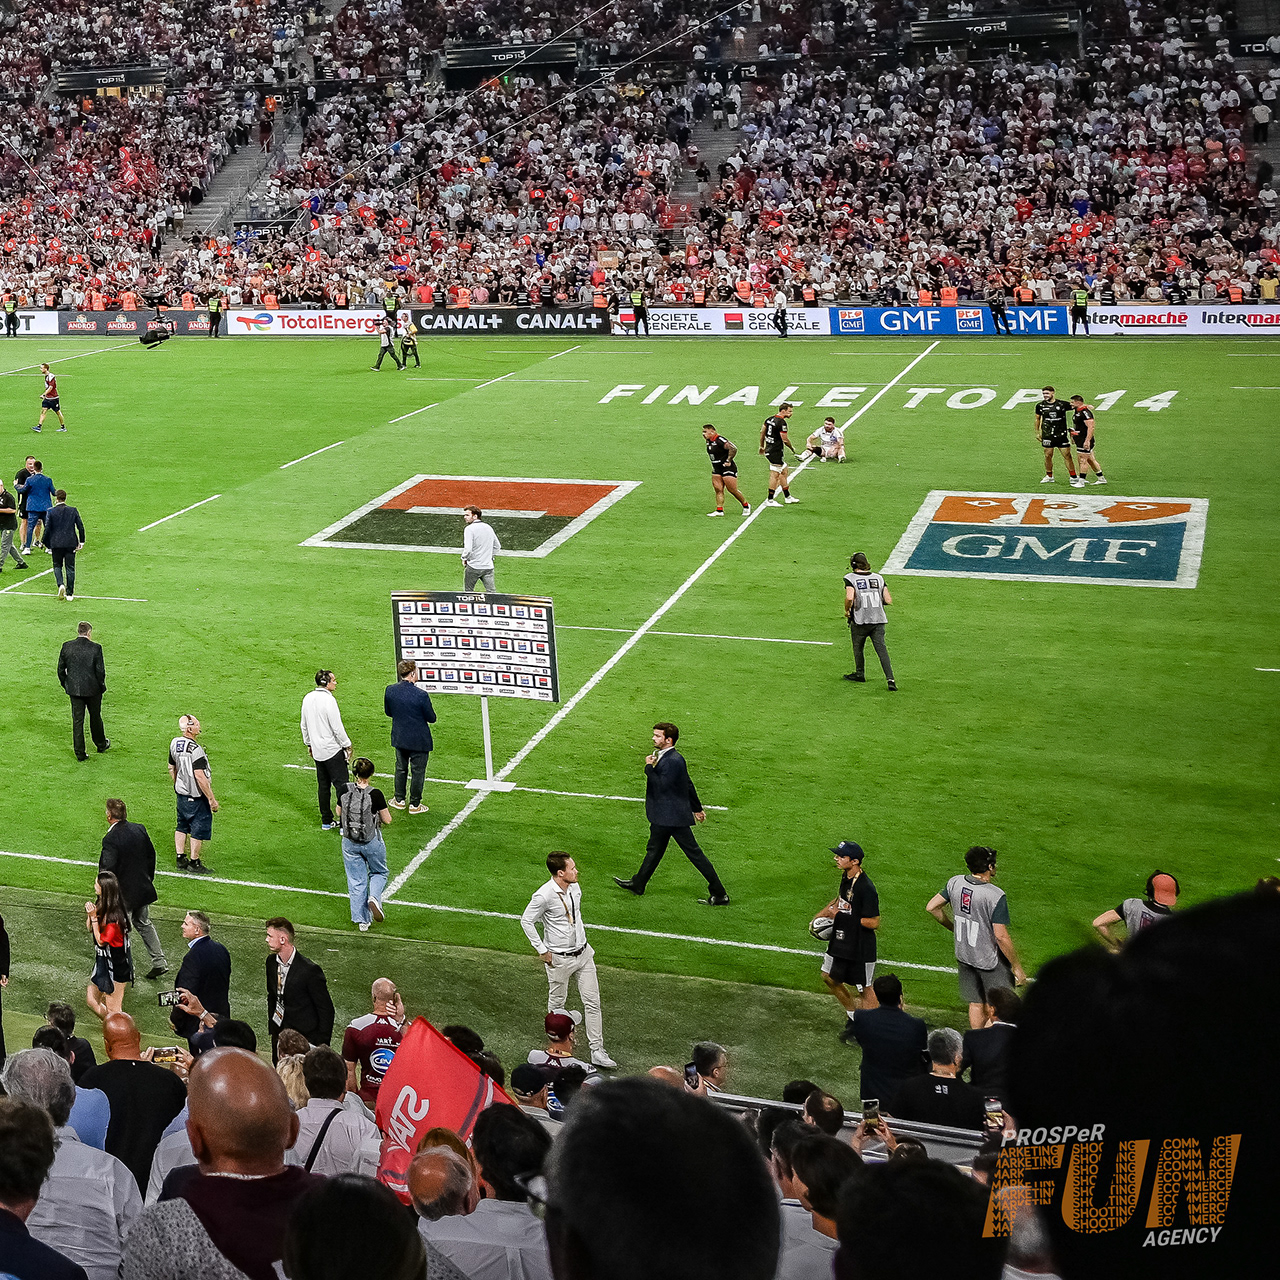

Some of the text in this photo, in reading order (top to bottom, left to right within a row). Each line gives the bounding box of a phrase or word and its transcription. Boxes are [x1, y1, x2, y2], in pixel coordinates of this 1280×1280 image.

[277, 314, 402, 332] TotalEnergs
[420, 314, 502, 329] CANAL+
[516, 313, 602, 329] CANAL+
[748, 312, 807, 321] SOCETE
[880, 310, 940, 331] GMF
[1081, 312, 1188, 327] ntermarché
[748, 322, 820, 330] GENRALE
[598, 384, 867, 407] FINALE
[903, 387, 1179, 412] TOP 14
[941, 533, 1158, 564] GMF
[455, 593, 486, 602] TOP14
[860, 591, 880, 608] TV
[954, 914, 979, 947] TV
